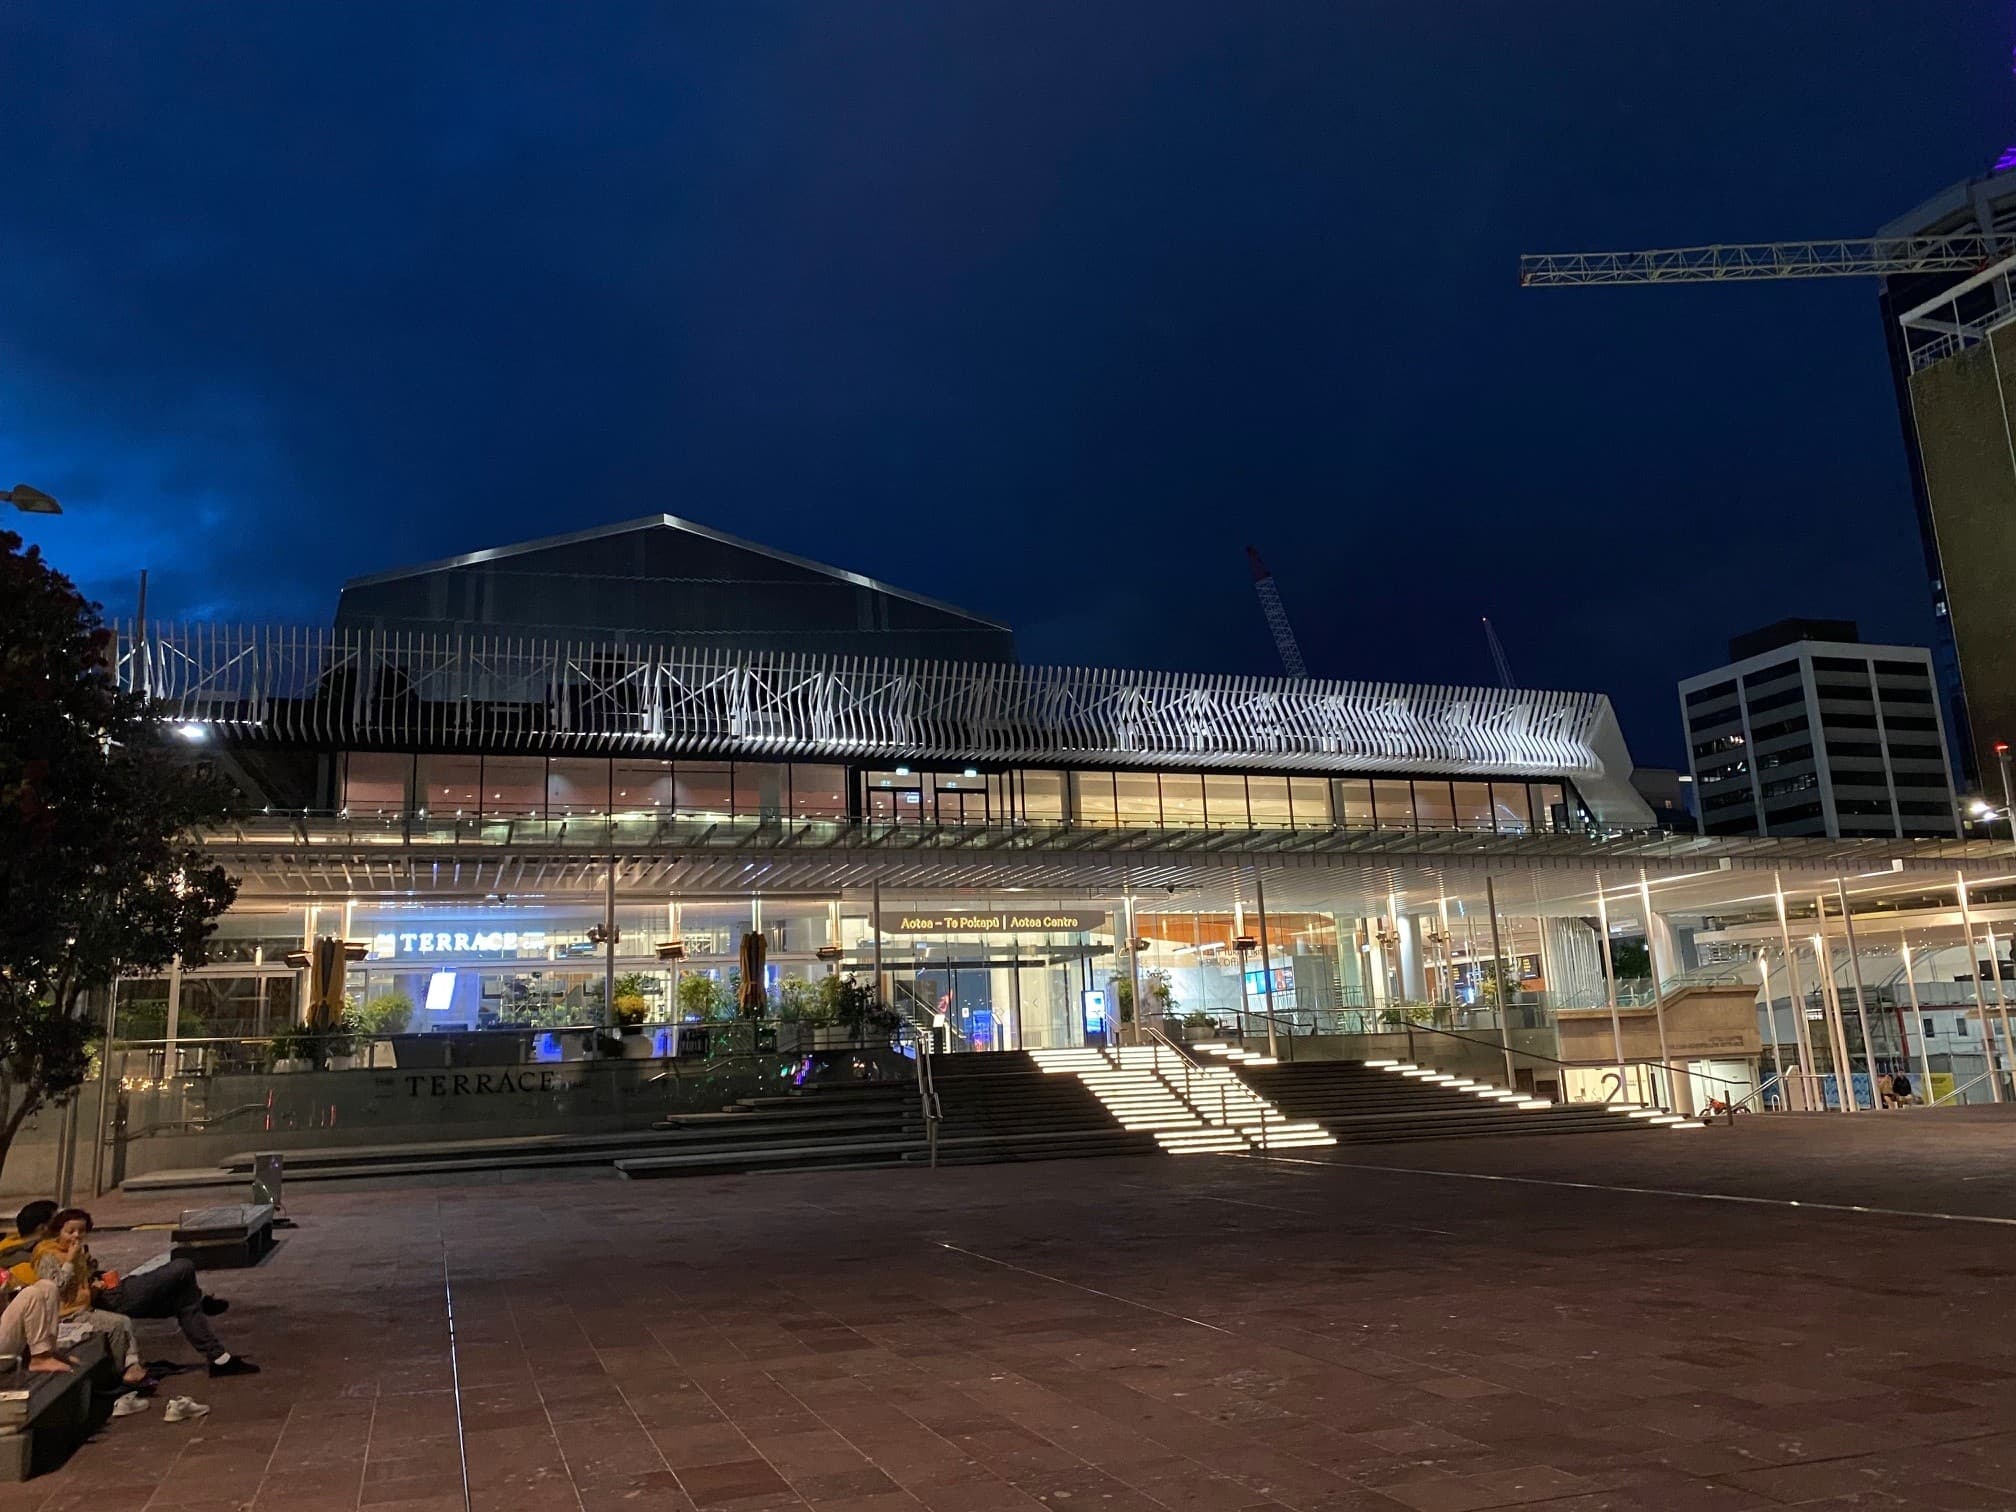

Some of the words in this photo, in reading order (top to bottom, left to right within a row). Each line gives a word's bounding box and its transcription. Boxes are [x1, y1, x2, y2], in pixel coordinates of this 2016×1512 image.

[901, 917, 934, 929] Aotea
[944, 917, 958, 929] Te
[1010, 916, 1042, 928] Aotea
[1043, 916, 1079, 928] Centre
[400, 932, 518, 952] TERRACE
[405, 1070, 555, 1097] TERRACE
